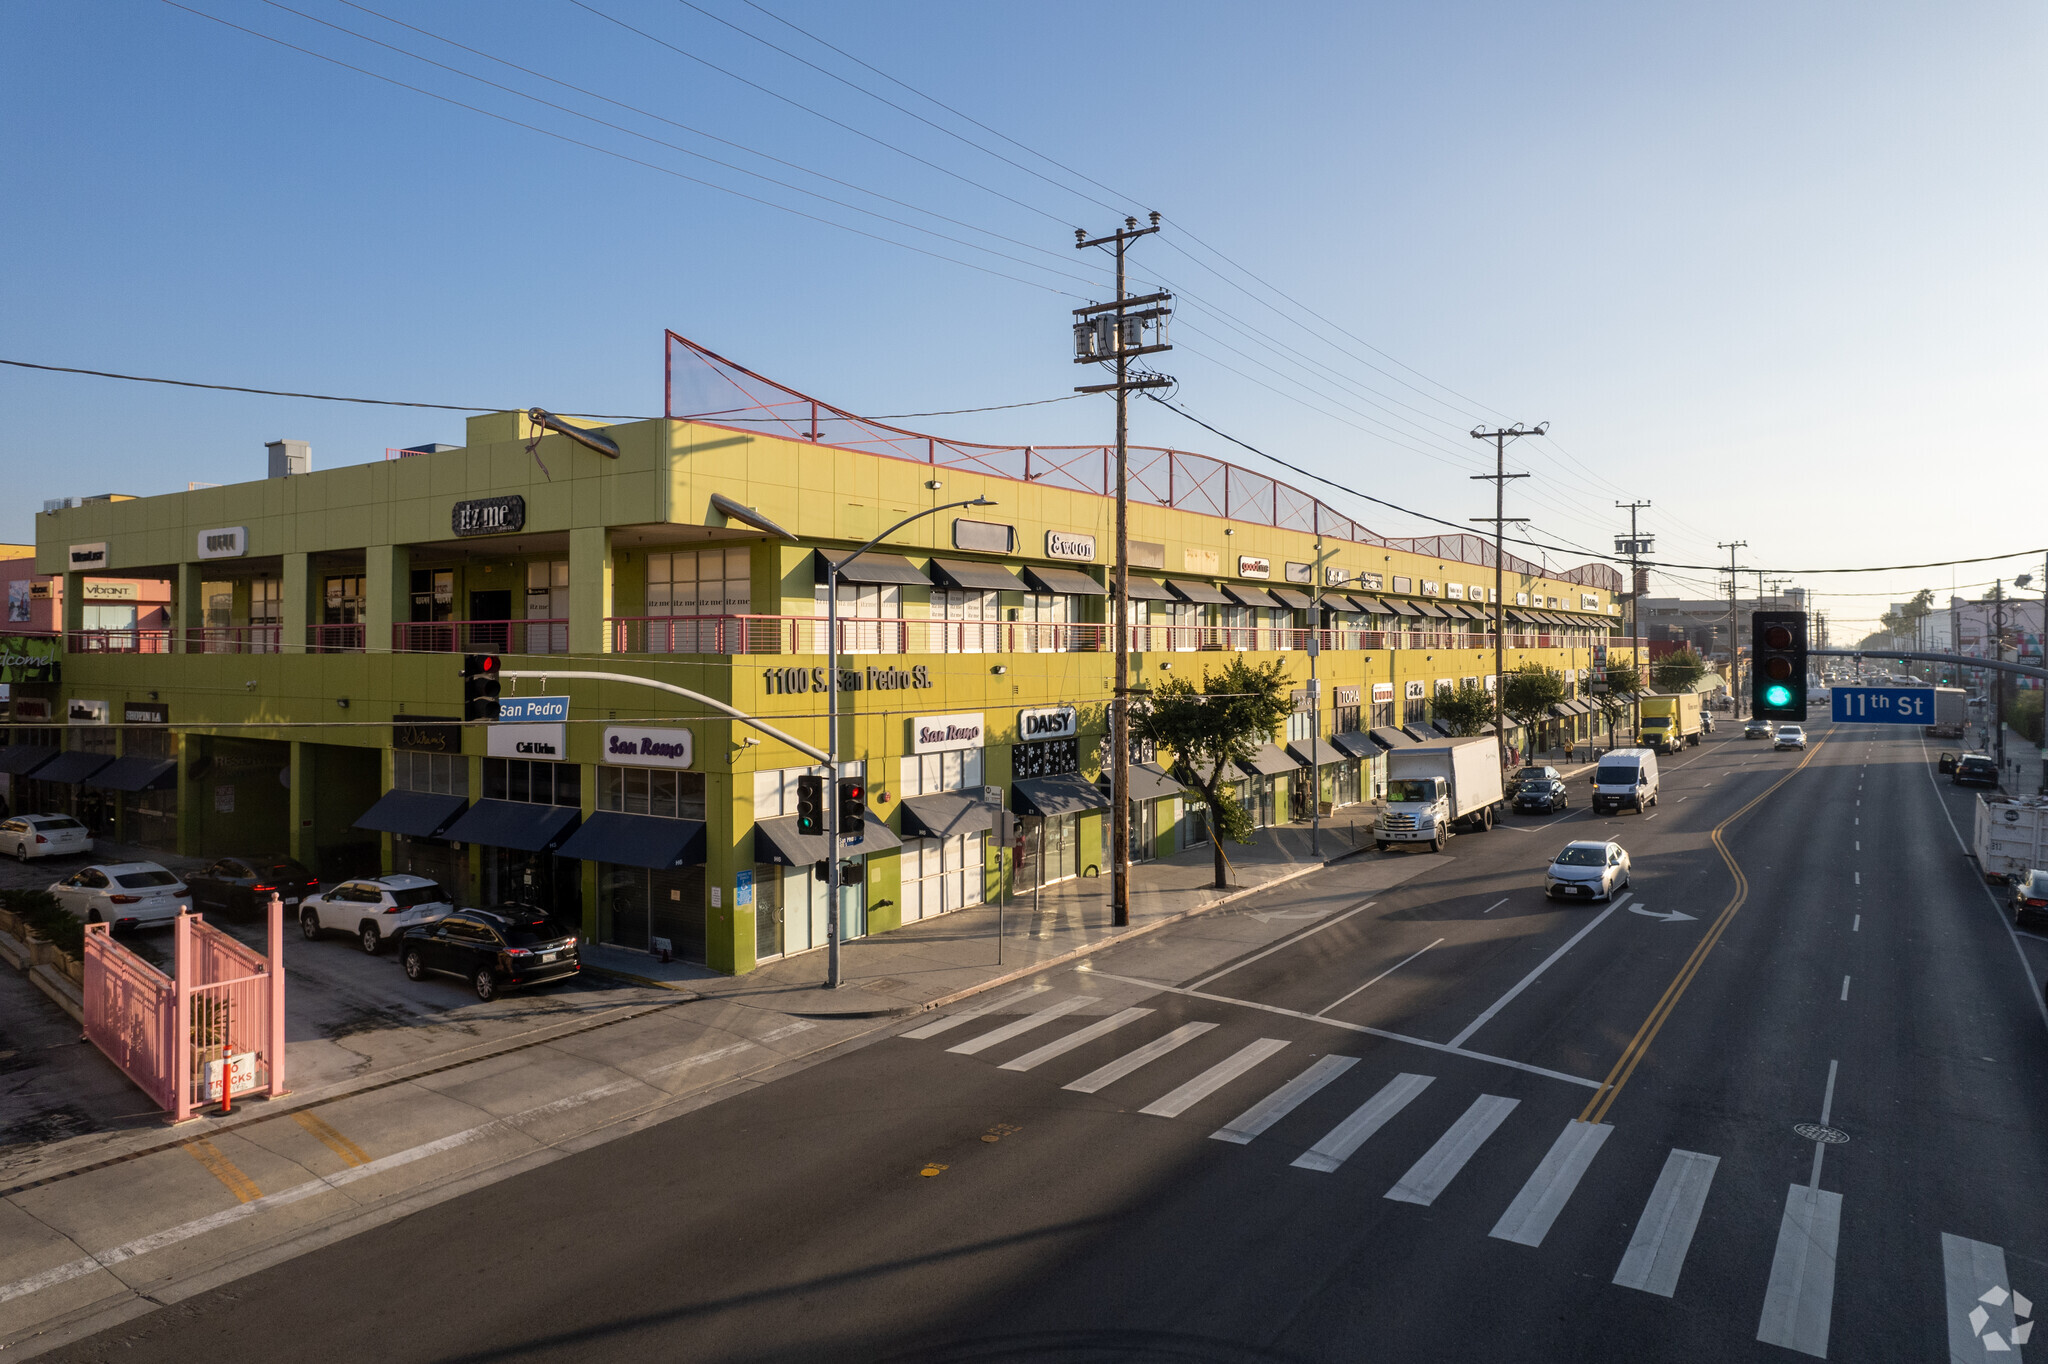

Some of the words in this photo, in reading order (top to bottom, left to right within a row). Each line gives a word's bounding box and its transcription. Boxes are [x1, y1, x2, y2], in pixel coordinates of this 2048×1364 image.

[460, 504, 479, 530] itz
[483, 504, 509, 527] me
[763, 667, 809, 695] 1100
[836, 666, 864, 692] San
[866, 666, 910, 690] Pedro
[912, 664, 933, 689] St.
[500, 705, 522, 716] San
[527, 702, 562, 716] Pedro
[1844, 693, 1890, 716] 11th
[1898, 696, 1924, 716] St
[920, 726, 945, 744] San
[946, 724, 980, 743] Remo
[1026, 713, 1072, 734] DAISY
[516, 742, 532, 754] Cali
[609, 735, 637, 754] San
[640, 737, 684, 759] Remo
[208, 1072, 252, 1090] TRCKS
